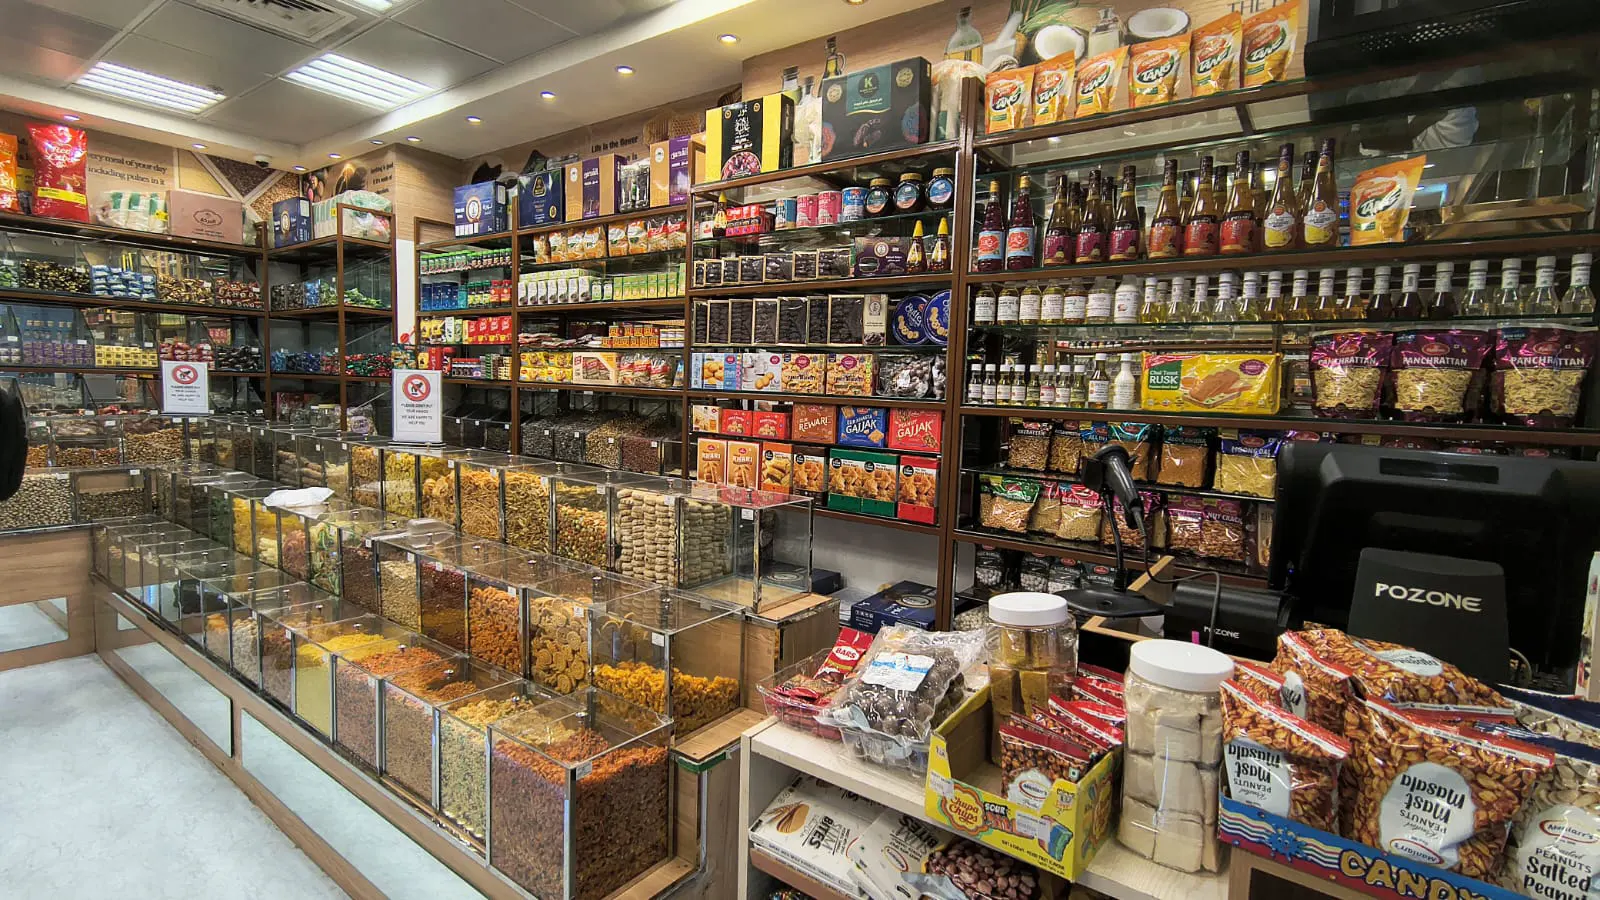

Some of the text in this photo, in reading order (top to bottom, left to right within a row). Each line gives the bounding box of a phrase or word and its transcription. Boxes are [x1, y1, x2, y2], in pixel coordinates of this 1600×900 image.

[1141, 62, 1170, 81] TANG
[864, 77, 873, 88] K
[609, 140, 619, 148] the
[105, 156, 125, 165] meal
[125, 159, 135, 167] of
[134, 161, 154, 172] your
[153, 163, 168, 175] day
[88, 167, 127, 181] including
[127, 172, 151, 184] pulses
[159, 177, 165, 185] it
[1403, 356, 1468, 366] PANCHRATTAN
[1149, 375, 1179, 385] RUSK
[799, 417, 828, 432] REWARI
[846, 419, 877, 434] GAJJAK
[897, 420, 932, 438] GAJJAK
[1208, 512, 1221, 520] NUT
[1375, 582, 1483, 612] POZONE
[1203, 626, 1240, 639] PZONE
[835, 647, 858, 660] BARS
[1235, 760, 1272, 784] Mast
[1233, 777, 1272, 793] PEANUTS
[1400, 774, 1466, 810] Masala
[949, 803, 979, 825] Chups
[951, 796, 980, 814] Chupa
[985, 803, 1007, 814] SOUR
[1404, 793, 1452, 824] Mast
[1400, 809, 1448, 834] PEANUTS
[809, 816, 834, 850] BITES
[1535, 847, 1592, 874] PEANUTS
[1526, 855, 1592, 893] Salted
